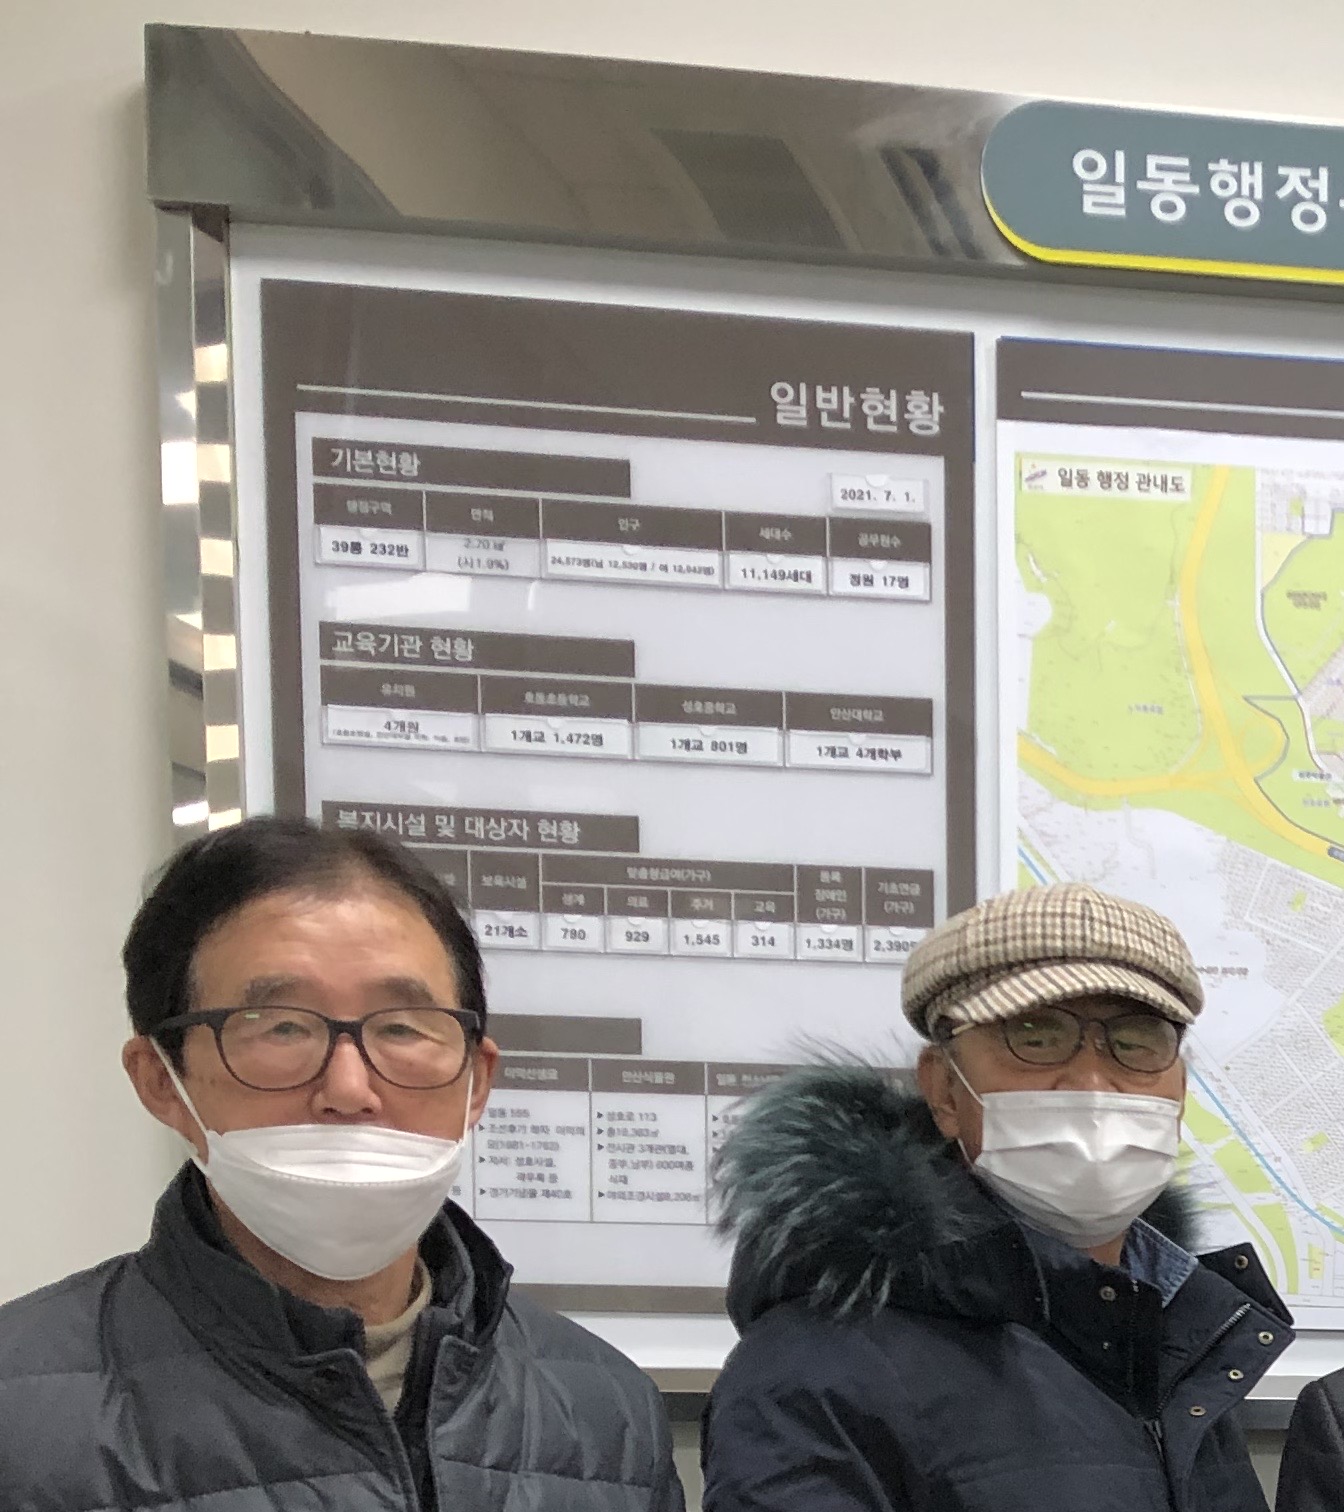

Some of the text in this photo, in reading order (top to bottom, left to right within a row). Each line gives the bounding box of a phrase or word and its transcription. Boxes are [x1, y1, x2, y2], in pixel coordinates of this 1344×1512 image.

[771, 381, 944, 436] 일반현황
[331, 449, 421, 477] 기본현황
[1057, 468, 1186, 493] 일동 행정 관내도
[840, 488, 877, 502] 2021.
[332, 632, 475, 662] 교육기관 현황
[338, 810, 581, 844] 복지시설 및 대상자 현황
[626, 931, 649, 943] 929
[752, 936, 775, 947] 314
